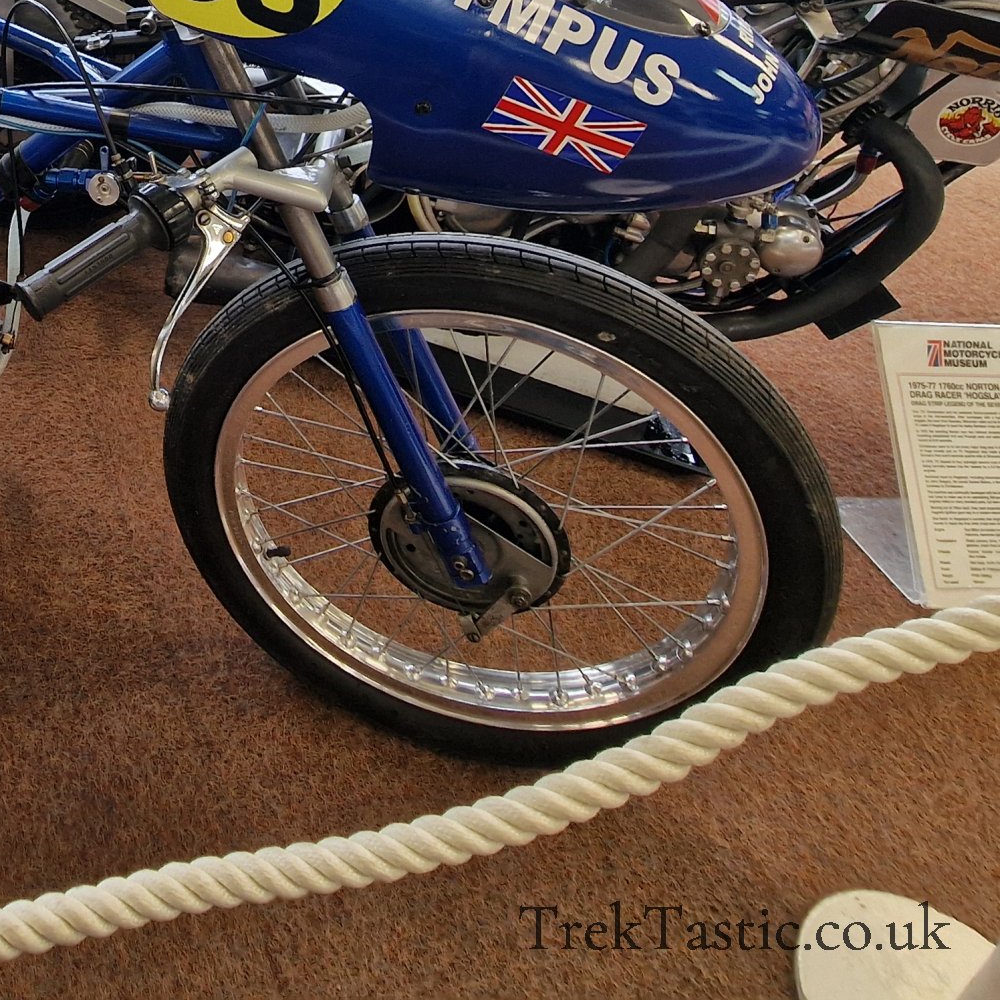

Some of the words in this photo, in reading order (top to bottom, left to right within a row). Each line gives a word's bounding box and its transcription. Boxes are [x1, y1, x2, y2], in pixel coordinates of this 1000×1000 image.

[943, 340, 993, 349] NATIONAL
[944, 359, 988, 368] MUSEUM
[966, 383, 1000, 391] NORTON
[910, 391, 933, 399] DRAG
[935, 391, 962, 399] RACER
